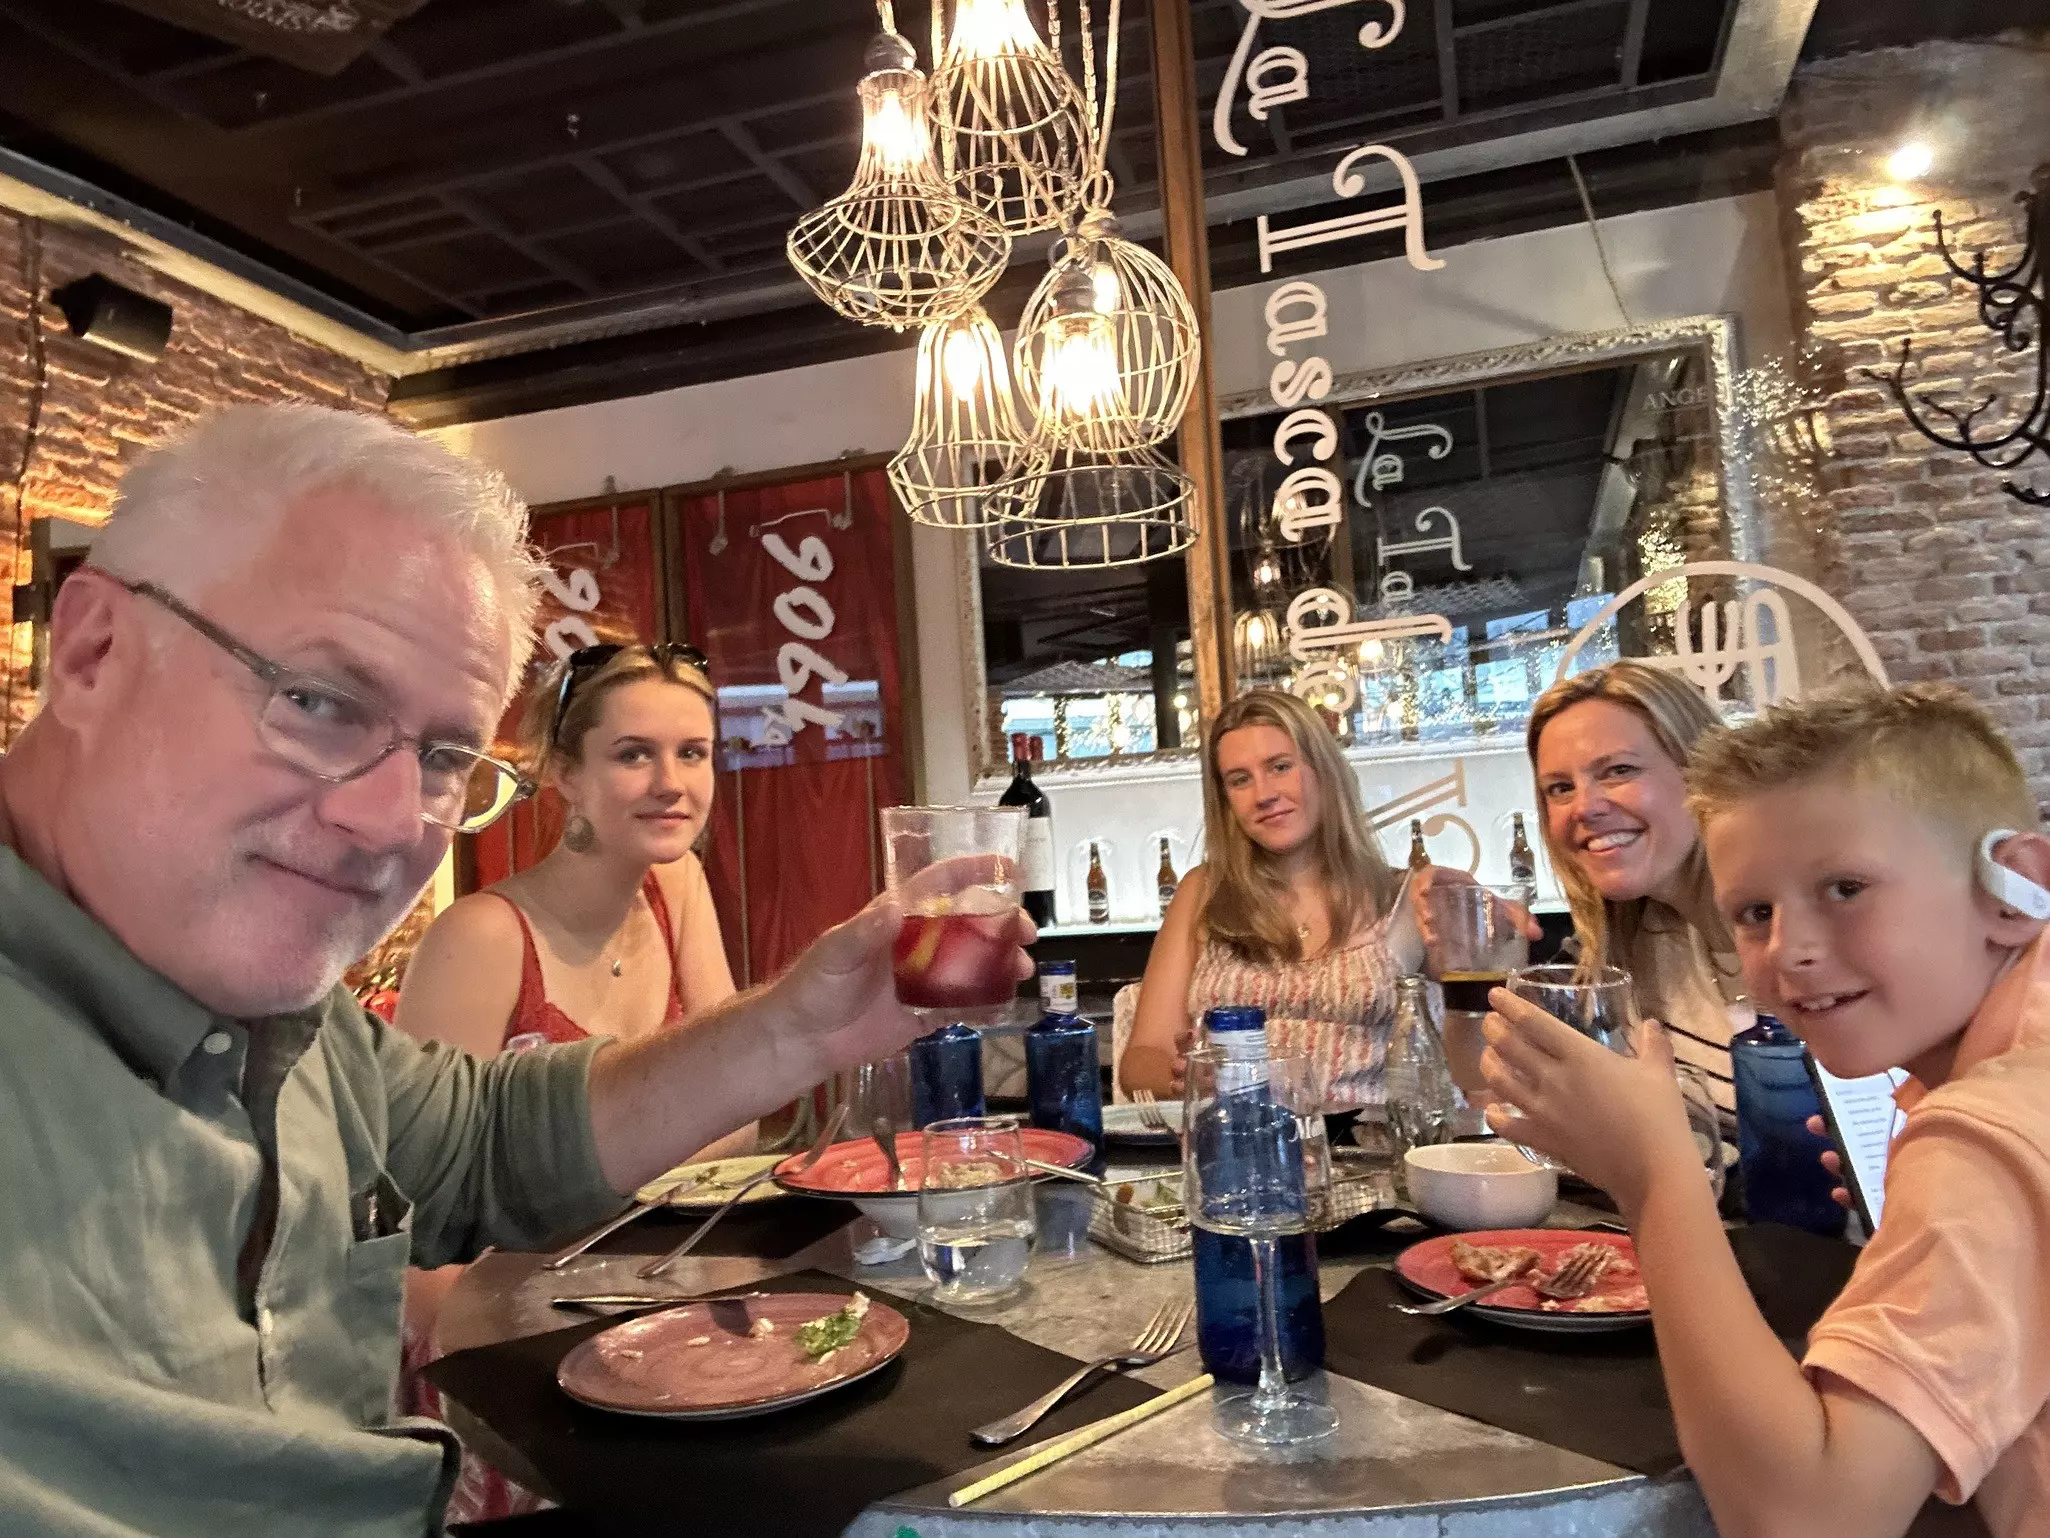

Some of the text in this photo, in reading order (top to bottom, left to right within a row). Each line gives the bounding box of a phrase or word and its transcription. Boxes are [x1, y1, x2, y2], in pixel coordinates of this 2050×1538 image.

[1213, 0, 1406, 157] La
[1257, 144, 1447, 542] Tasca
[1354, 410, 1454, 508] La
[540, 567, 601, 656] 06
[762, 532, 849, 733] 1906
